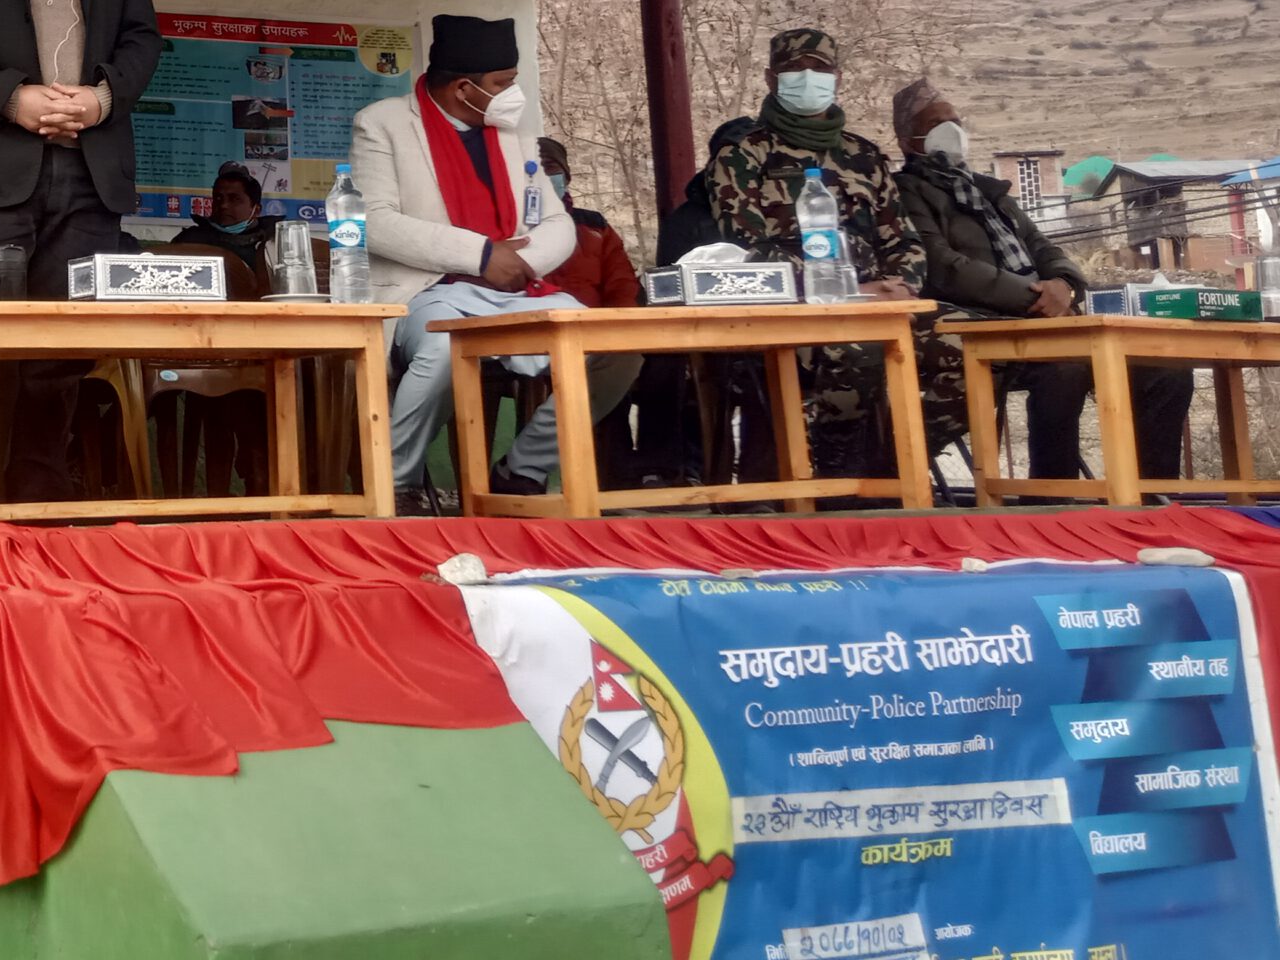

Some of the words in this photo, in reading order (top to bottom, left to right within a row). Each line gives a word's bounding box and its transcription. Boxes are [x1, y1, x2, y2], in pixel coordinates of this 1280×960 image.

[212, 22, 256, 36] सुरक्षाका
[261, 24, 310, 39] उपायहरू
[1198, 292, 1241, 306] FORTUNE
[1057, 606, 1098, 630] नेपाल
[1102, 603, 1141, 630] प्रहरी
[719, 631, 910, 687] समुदाय-प्रहरी
[1148, 655, 1206, 680] स्थानीय
[1208, 657, 1229, 678] तह
[744, 695, 925, 729] Community-Police
[928, 687, 1023, 717] Partnership
[1069, 718, 1131, 743] समुदाय
[1135, 765, 1202, 793] सामाजिक
[1204, 765, 1240, 787] संस्था
[860, 837, 954, 866] कार्यक्रम
[1089, 831, 1147, 855] विद्यालय
